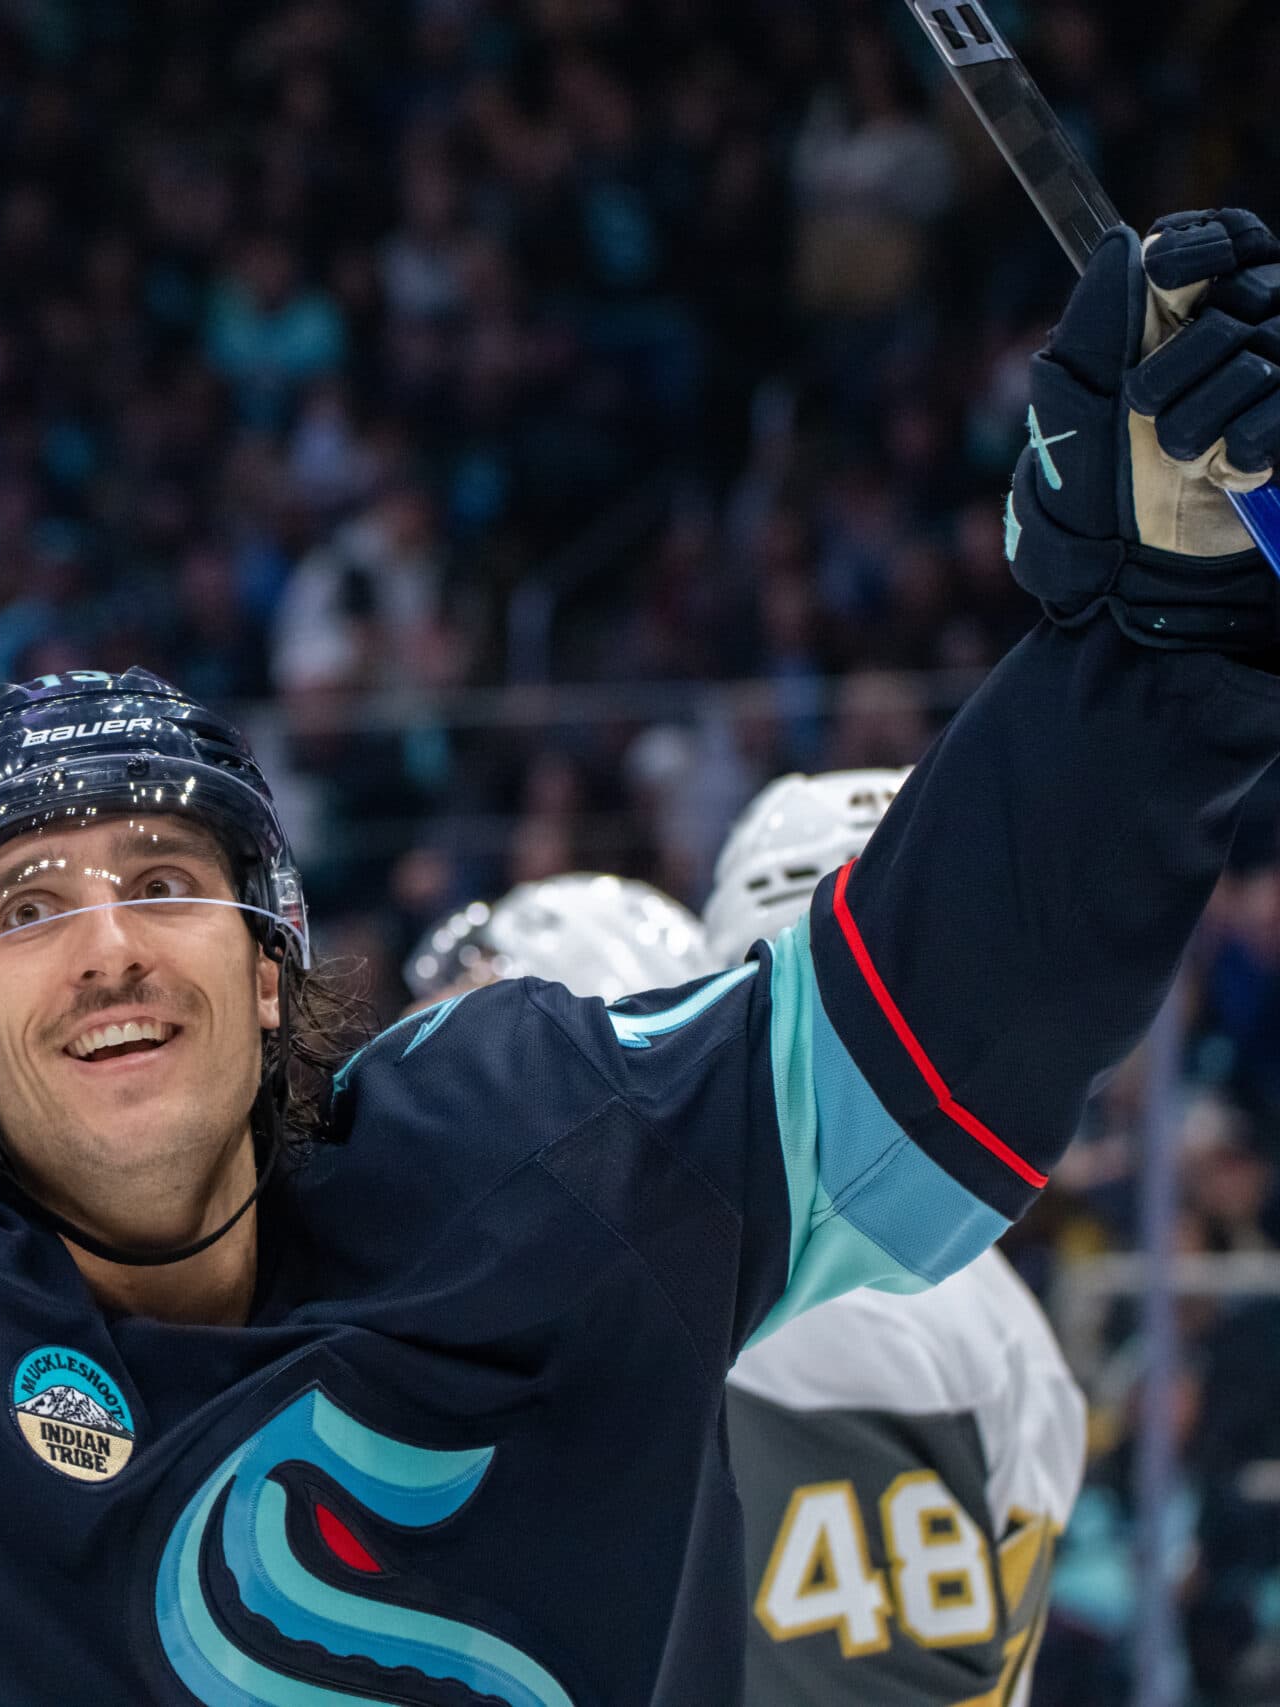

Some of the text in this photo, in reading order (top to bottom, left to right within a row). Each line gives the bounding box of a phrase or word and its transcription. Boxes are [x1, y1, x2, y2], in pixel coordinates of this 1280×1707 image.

[21, 1353, 125, 1420] MUCKLESHOOT
[40, 1422, 111, 1457] INDIAN
[46, 1442, 108, 1474] TRIBE
[754, 1469, 997, 1660] 48
